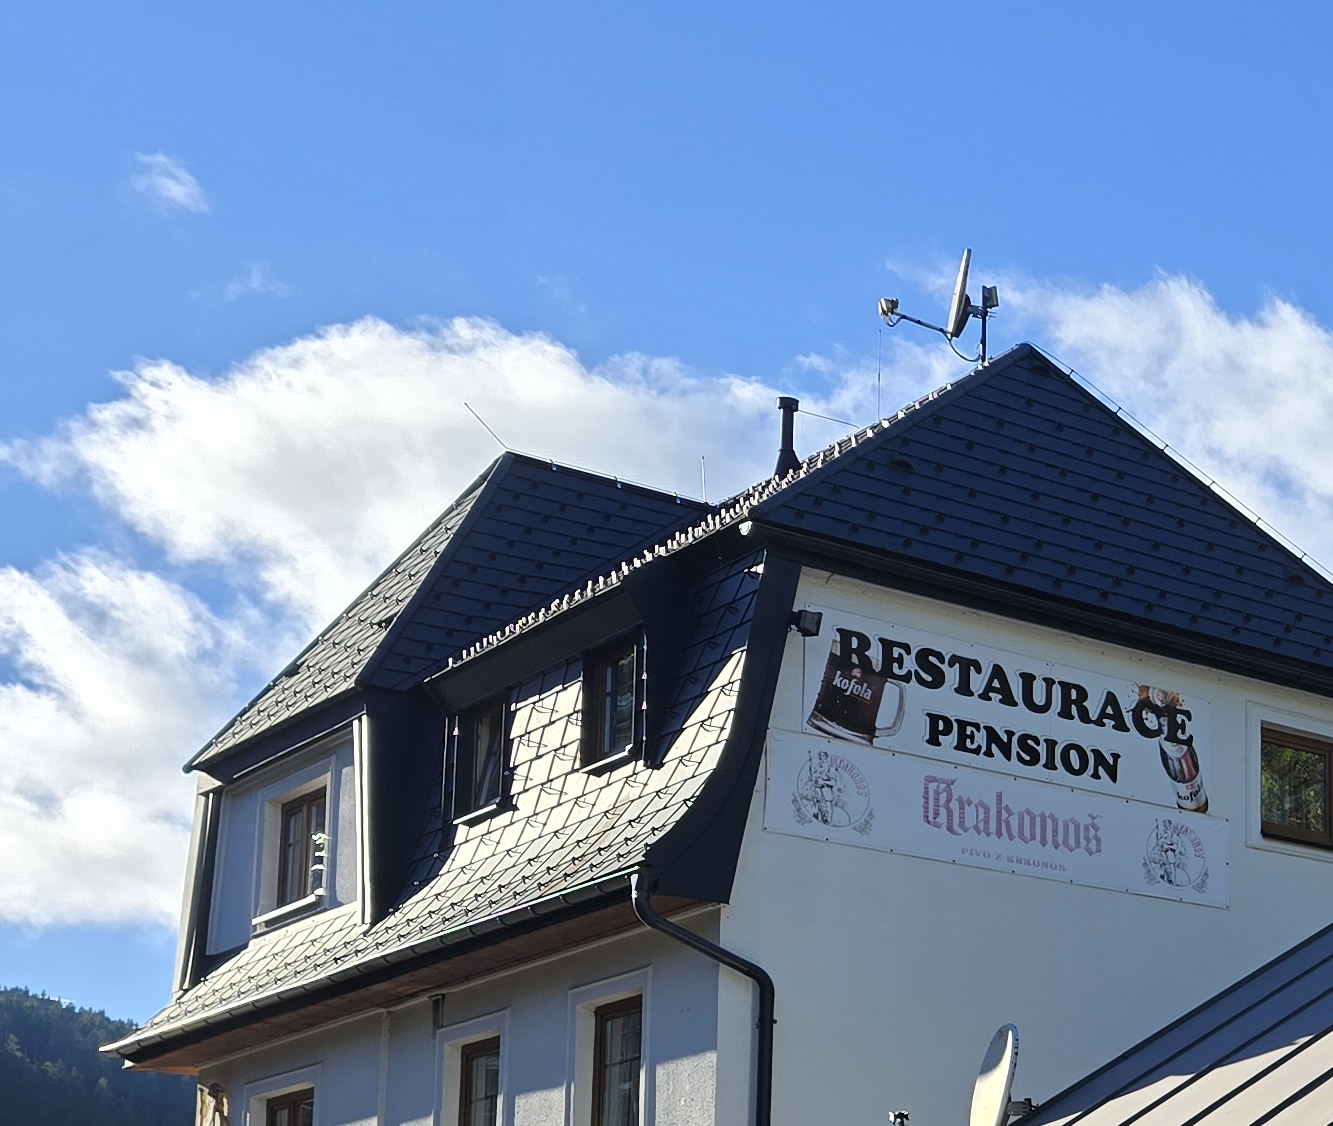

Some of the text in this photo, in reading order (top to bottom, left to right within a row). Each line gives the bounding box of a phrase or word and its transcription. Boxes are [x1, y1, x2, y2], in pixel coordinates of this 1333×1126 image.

[832, 670, 872, 701] kofola
[836, 628, 1194, 746] RESTAURACE
[925, 712, 1121, 784] PENSION
[922, 774, 1102, 856] Krakonoš
[961, 846, 991, 859] PIVO
[995, 852, 1002, 861] Z
